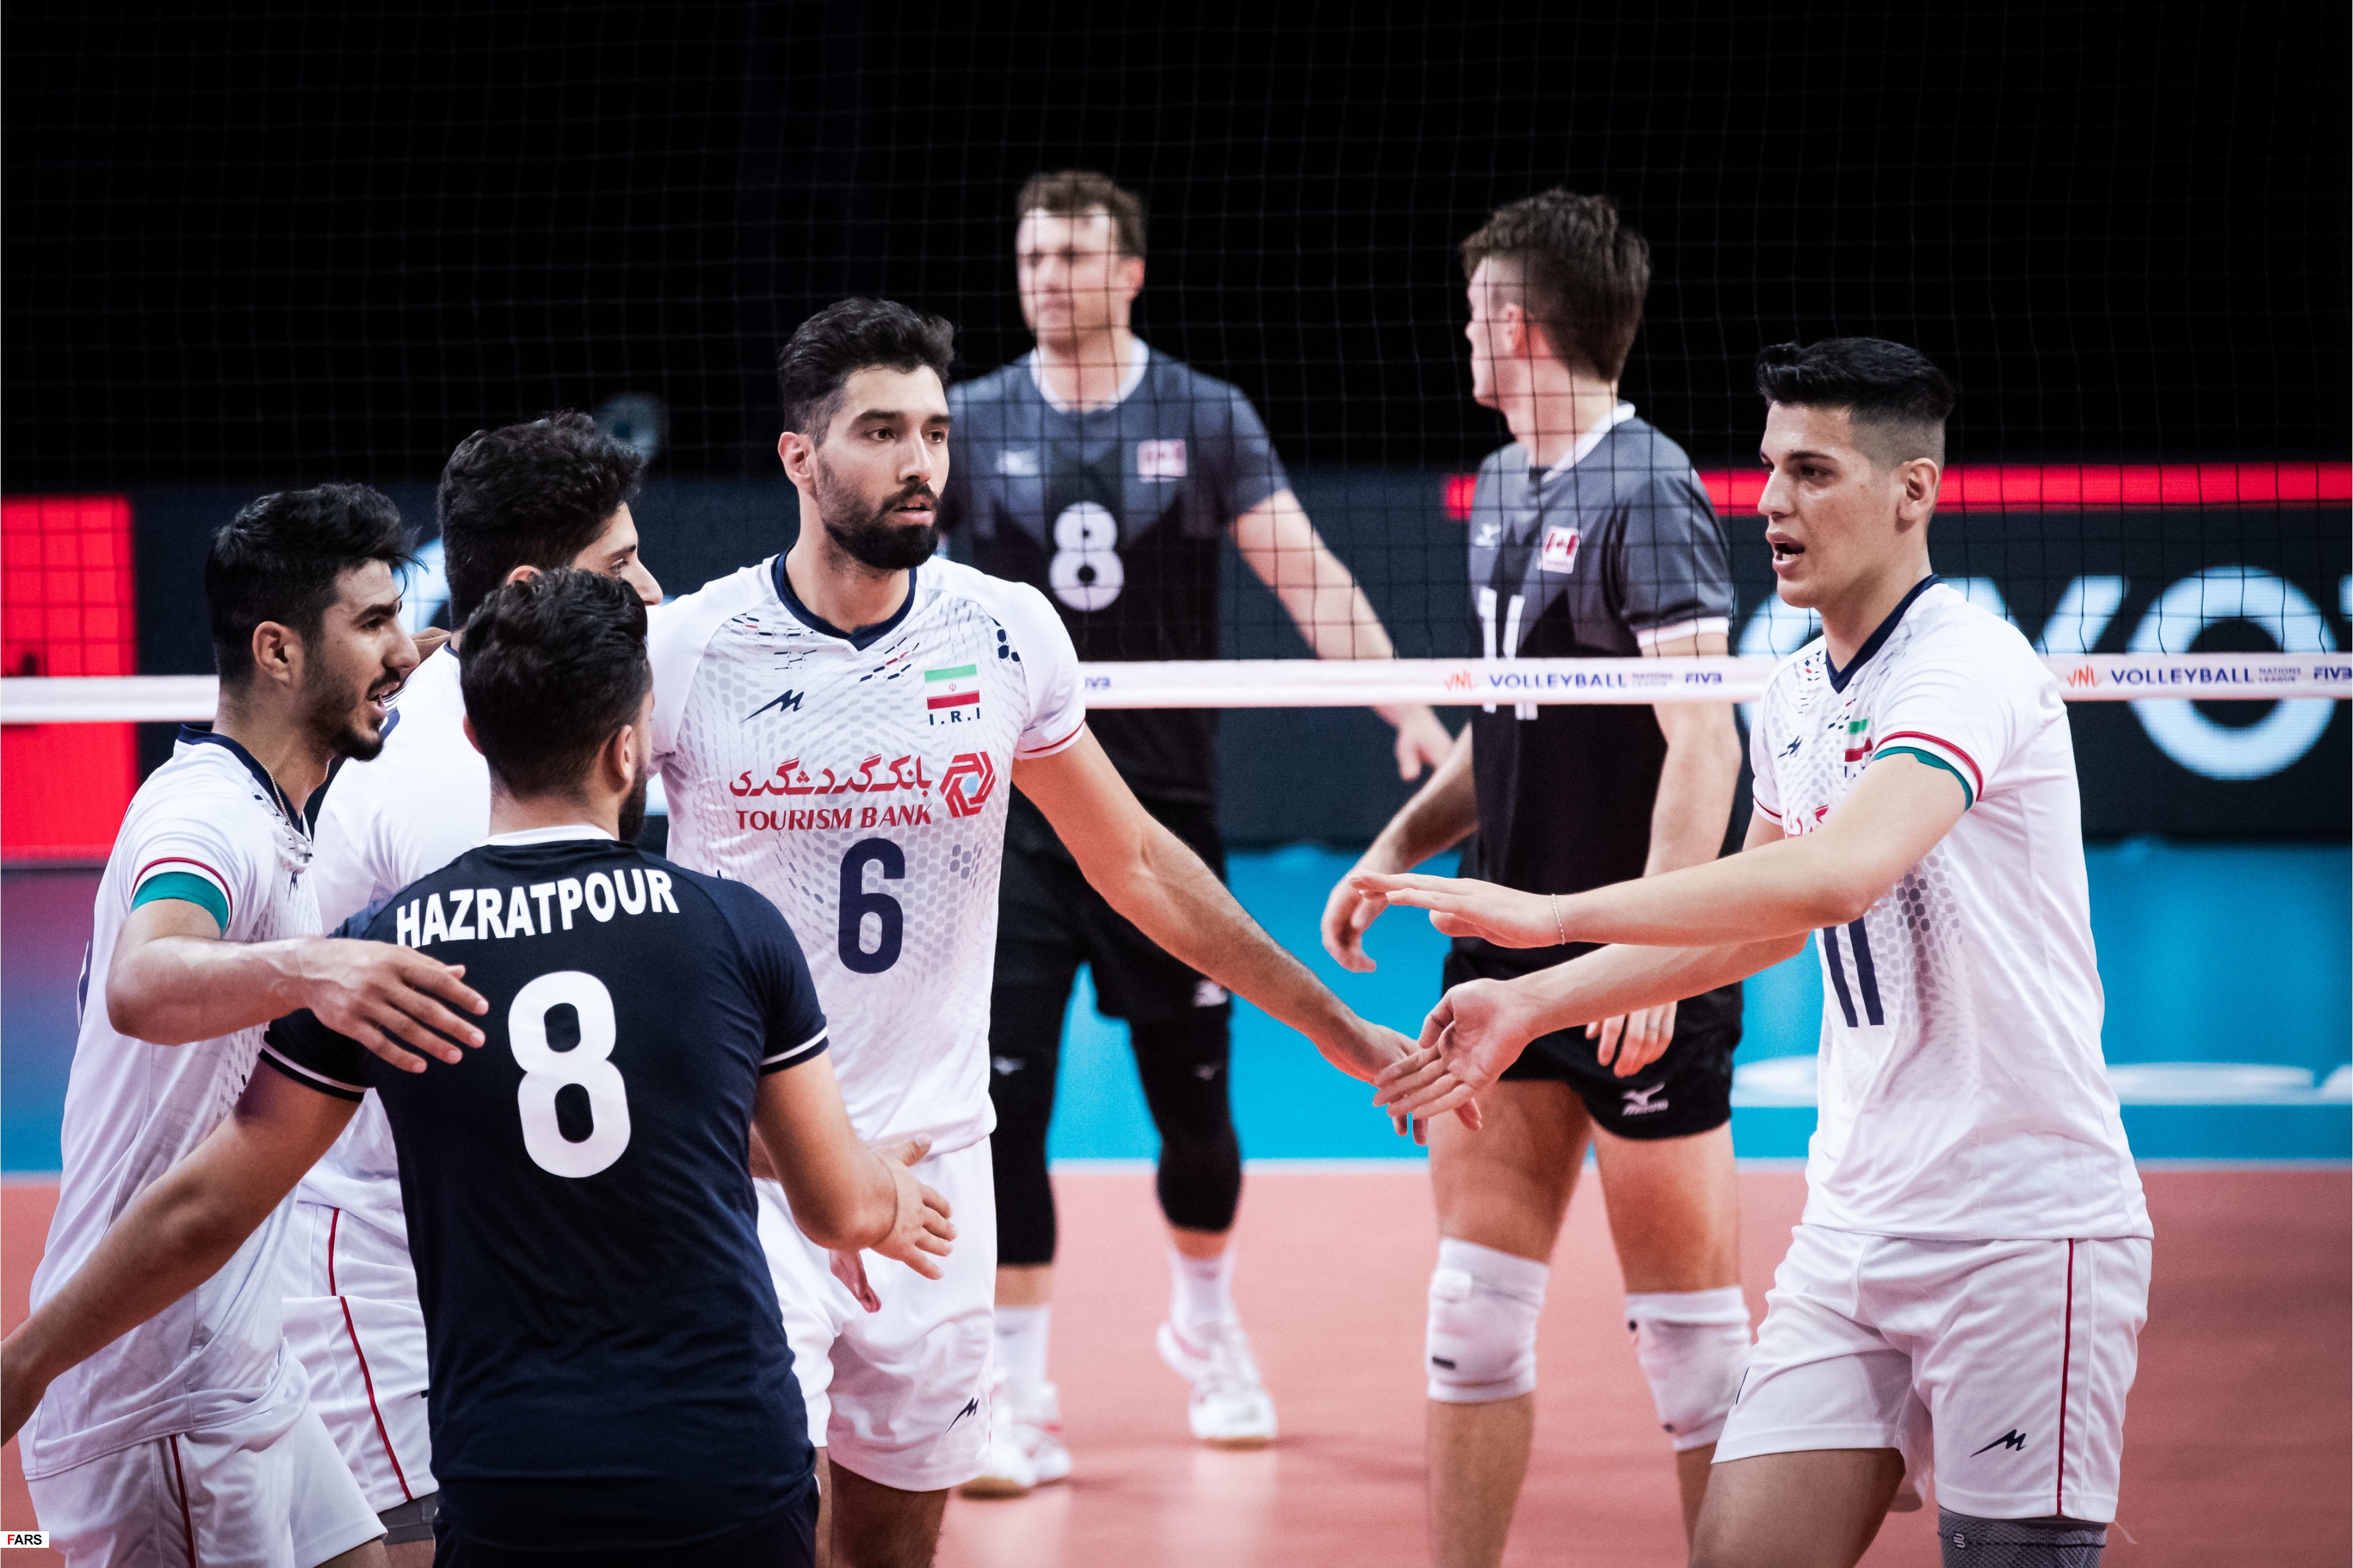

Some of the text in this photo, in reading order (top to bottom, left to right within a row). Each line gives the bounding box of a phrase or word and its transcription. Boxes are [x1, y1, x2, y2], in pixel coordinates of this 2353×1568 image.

[1048, 501, 1124, 612] 8
[1490, 673, 1626, 688] VOLLEYBALL
[2111, 667, 2254, 685] VOLLEYBALL
[729, 753, 933, 797] بانک گردشگری
[736, 803, 932, 831] TOURISM BANK
[396, 868, 680, 949] HAZRATPOUR
[838, 837, 905, 974] 6
[508, 970, 631, 1178] 8
